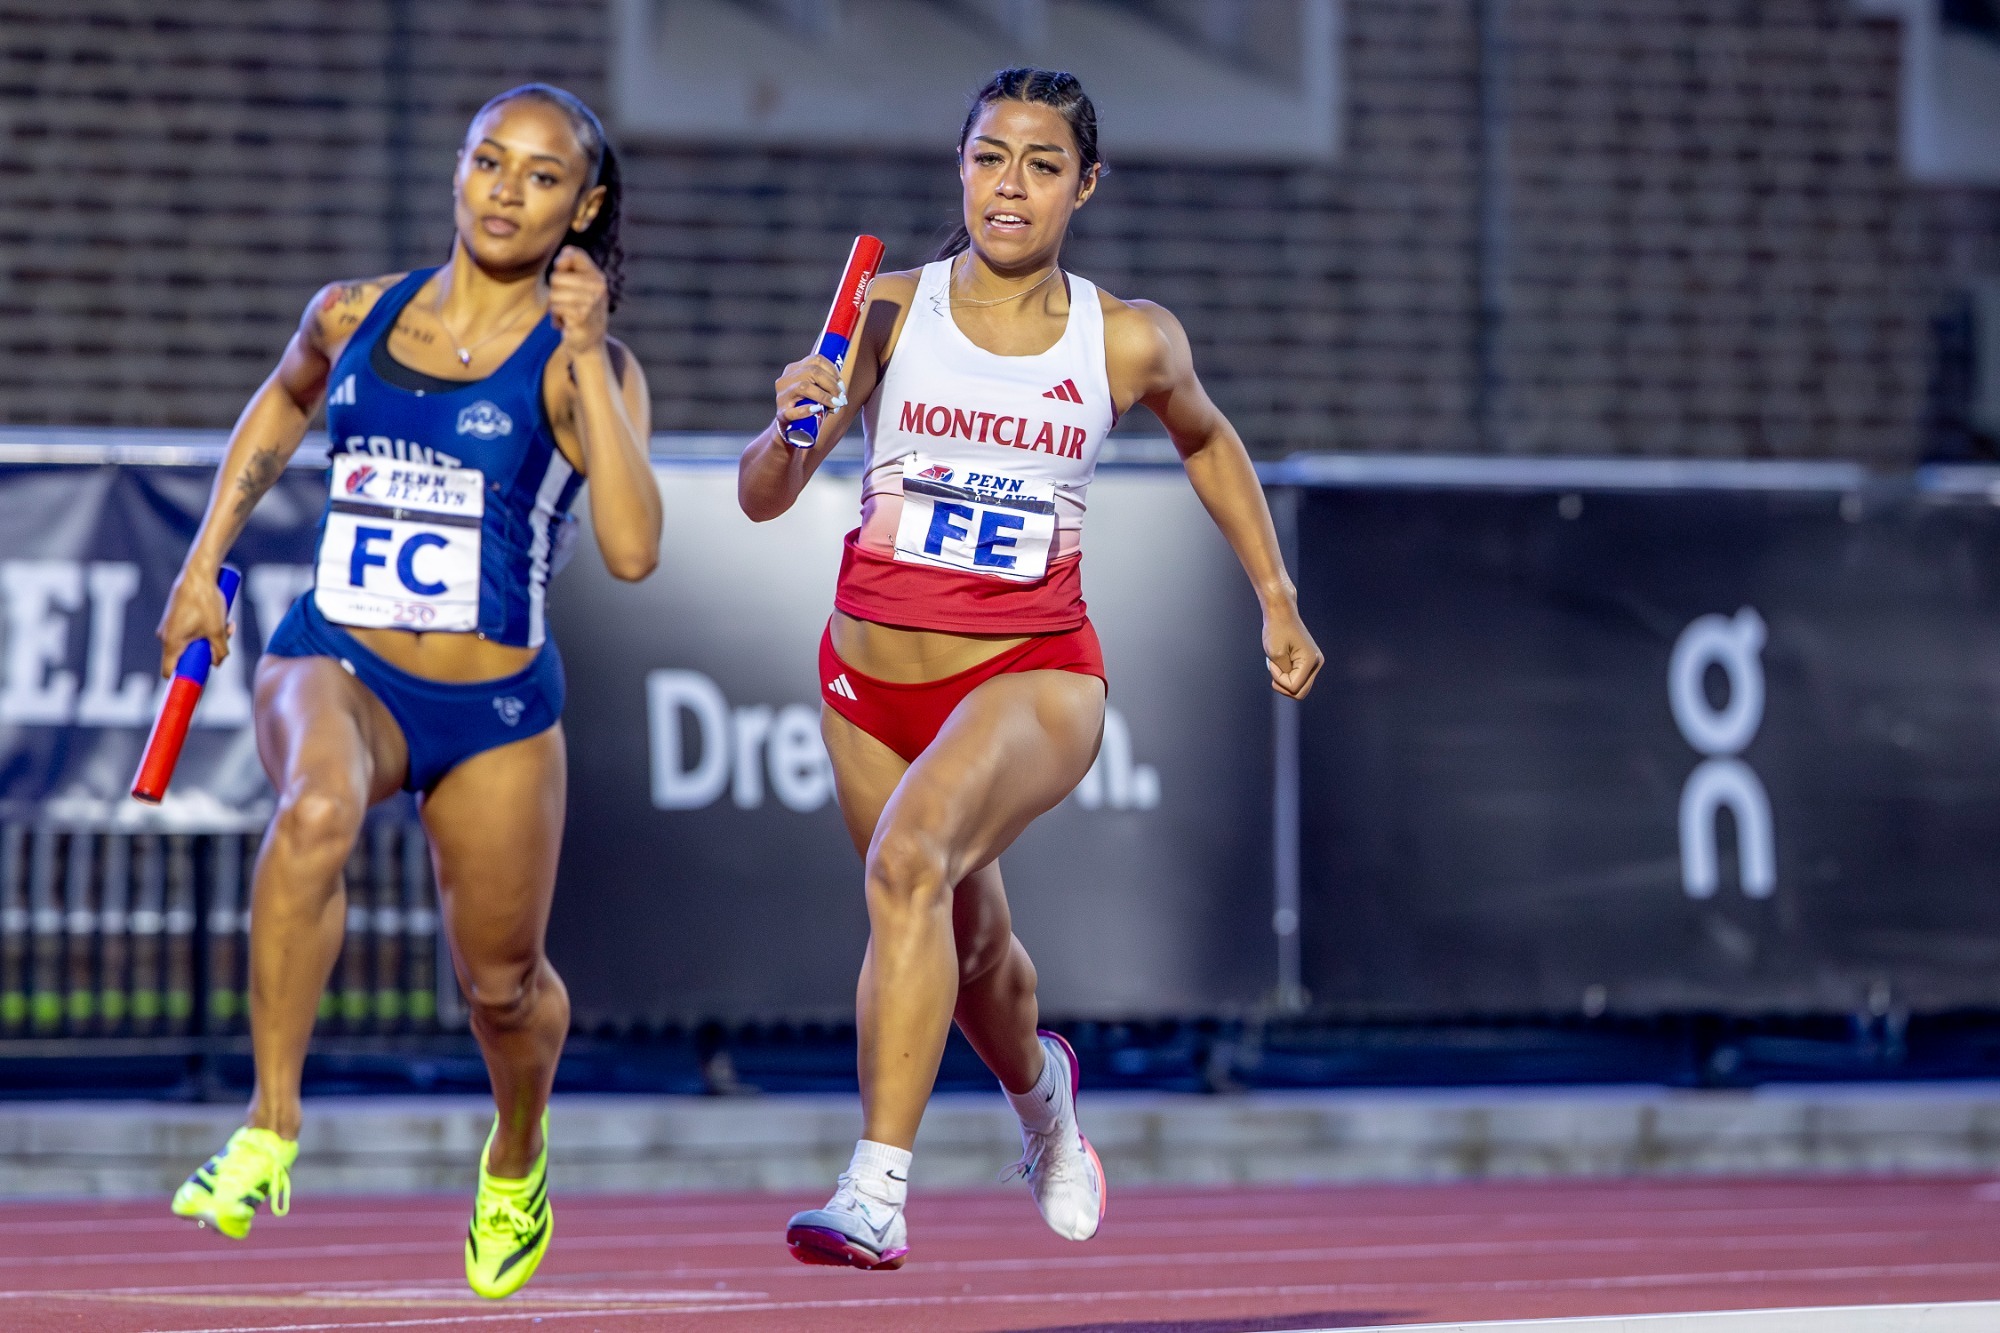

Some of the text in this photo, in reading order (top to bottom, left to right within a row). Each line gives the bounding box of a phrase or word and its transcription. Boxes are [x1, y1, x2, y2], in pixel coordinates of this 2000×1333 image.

[852, 270, 871, 308] AMERICA
[899, 401, 1087, 460] MONTCLAIR
[391, 469, 447, 487] PENN
[964, 472, 1025, 493] PENN
[348, 525, 449, 596] FC
[924, 500, 1025, 570] FE
[646, 668, 834, 812] Dre
